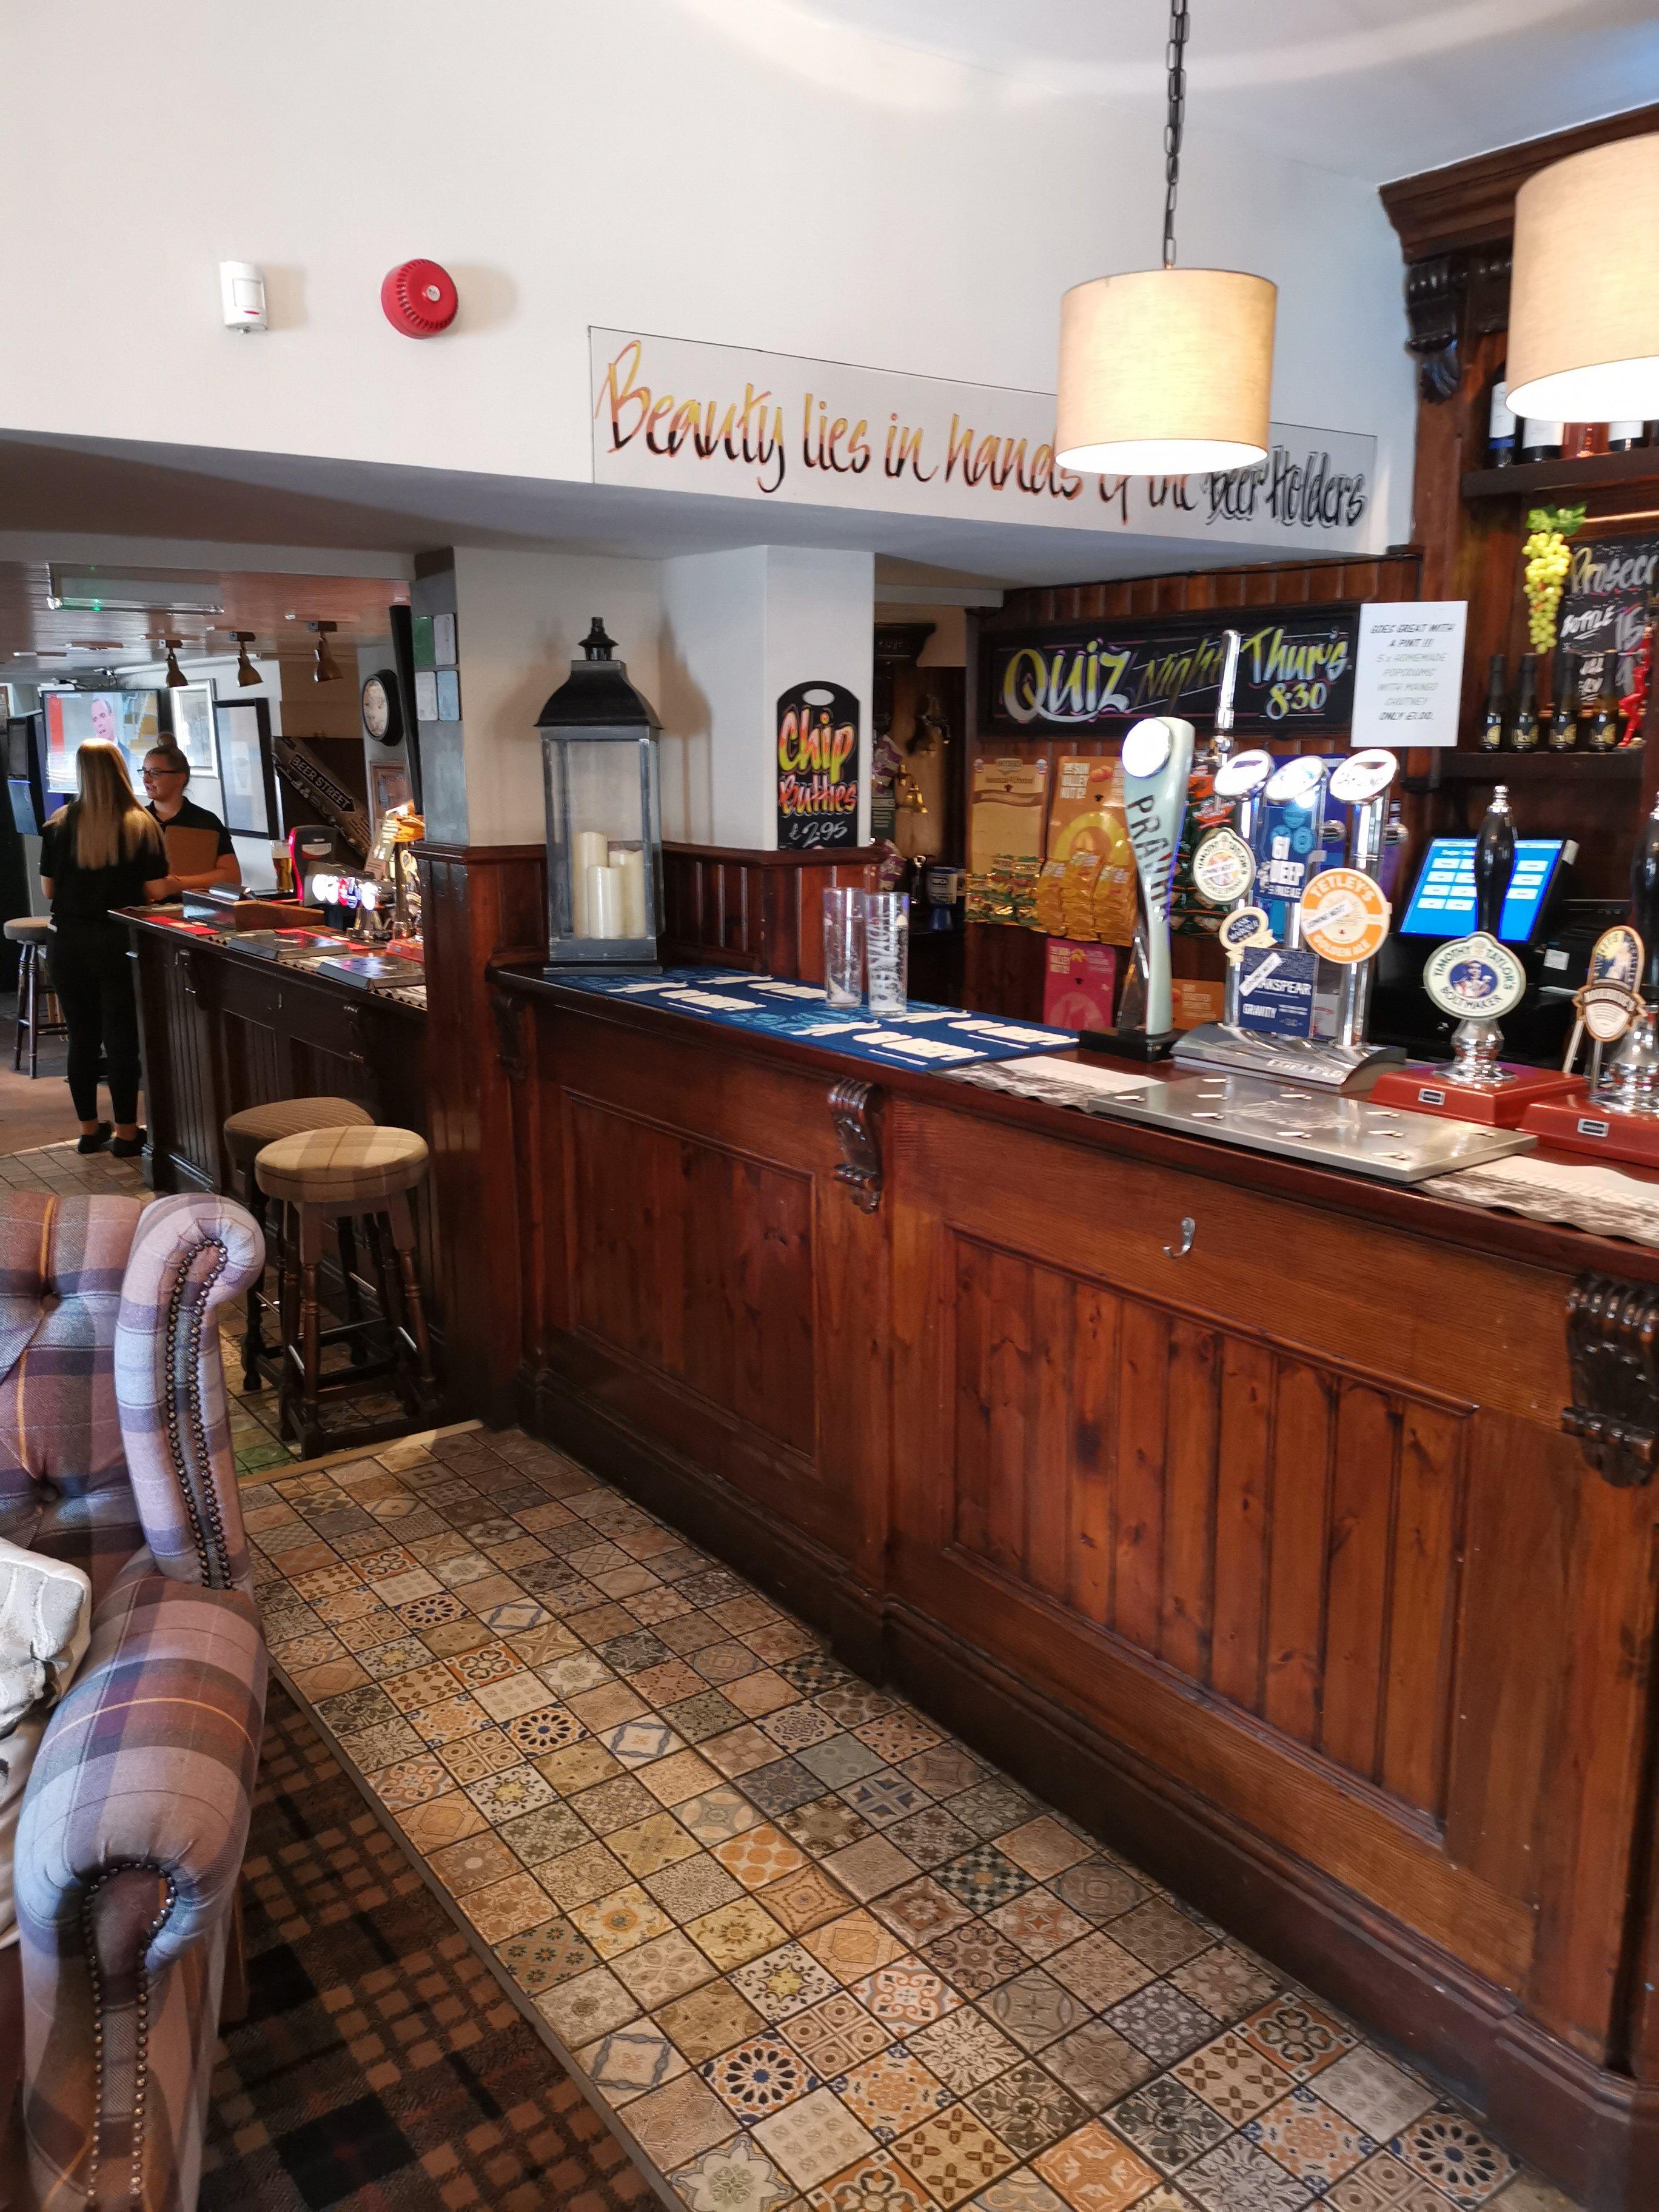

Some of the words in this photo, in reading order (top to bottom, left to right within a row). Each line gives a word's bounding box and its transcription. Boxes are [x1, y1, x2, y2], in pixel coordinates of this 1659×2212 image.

[595, 340, 786, 493] Beauty
[802, 392, 871, 474] lies
[884, 412, 939, 483] in
[945, 413, 1084, 500] hands
[1370, 625, 1396, 634] GOES
[1396, 624, 1427, 633] GREAT
[1429, 623, 1456, 632] WITH
[1388, 638, 1396, 648] A
[1396, 638, 1421, 647] PINT
[1378, 711, 1405, 720] ONLY
[779, 707, 856, 784] Chip
[292, 757, 318, 782] BEER
[315, 777, 351, 809] STREET
[788, 820, 848, 848] £2.95
[1310, 874, 1375, 902] TETLEY'S
